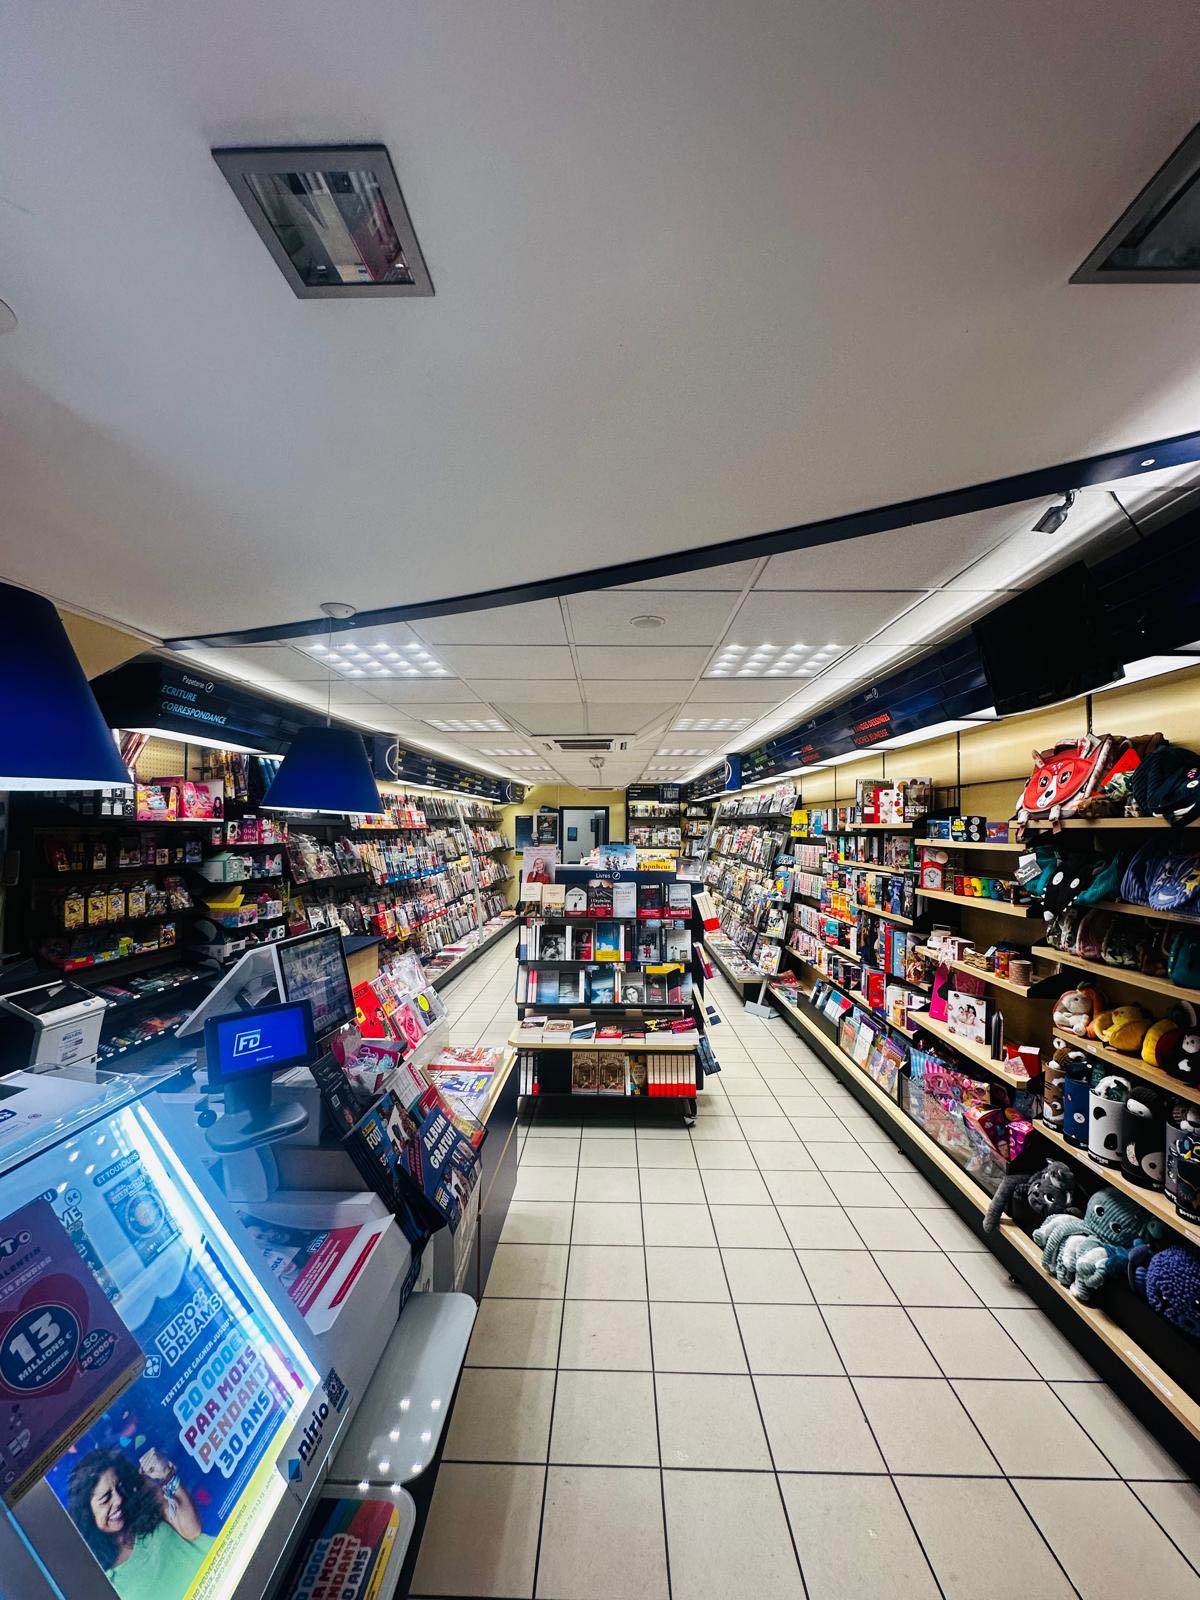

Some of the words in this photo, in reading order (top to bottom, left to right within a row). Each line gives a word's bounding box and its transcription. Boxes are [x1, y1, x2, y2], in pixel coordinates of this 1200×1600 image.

[161, 701, 228, 724] CORRESPONDANCE
[366, 1125, 384, 1150] FOOT
[423, 1114, 447, 1152] ALBUM
[430, 1124, 457, 1169] GRATUIT
[10, 1312, 61, 1364] 13
[157, 1304, 197, 1349] EURO
[164, 1293, 223, 1364] DREAMS
[18, 1338, 66, 1381] MILLIONS
[42, 1350, 70, 1376] GAGNER
[160, 1376, 185, 1407] TENTEZ
[184, 1366, 194, 1379] DE
[191, 1340, 214, 1370] GAGNER
[178, 1385, 204, 1422] 20
[184, 1399, 221, 1449] PAR
[217, 1345, 257, 1401] MOIS
[199, 1361, 268, 1465] PENDANT
[218, 1433, 244, 1472] 30
[240, 1390, 272, 1440] ANS
[298, 1402, 329, 1462] nirio
[318, 1536, 345, 1583] MOIS
